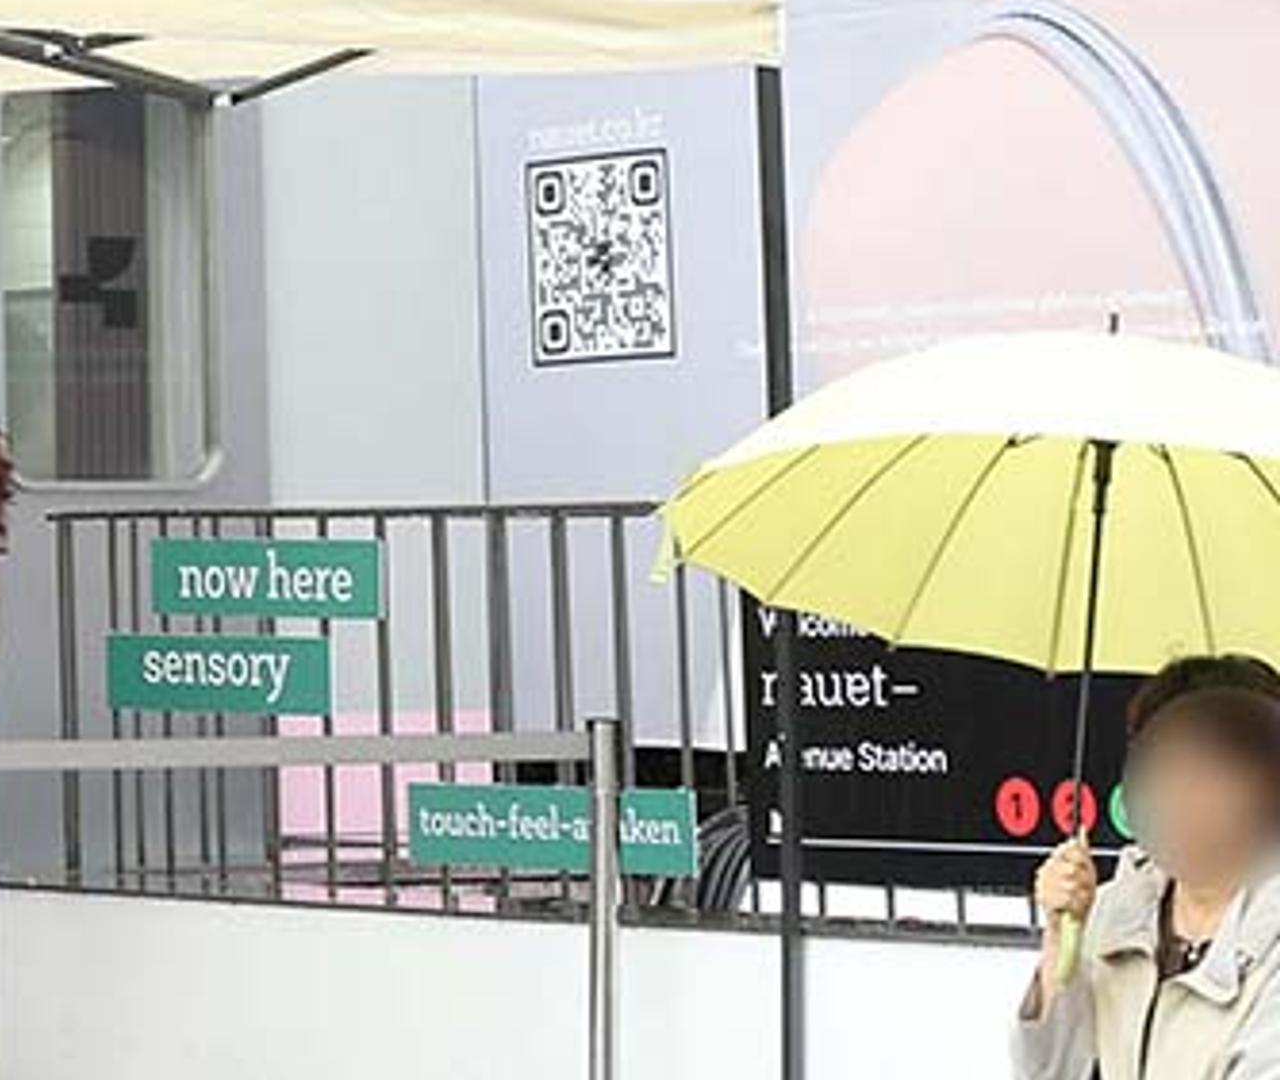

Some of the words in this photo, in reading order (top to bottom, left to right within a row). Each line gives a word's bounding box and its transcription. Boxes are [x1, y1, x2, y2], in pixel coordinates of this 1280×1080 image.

[179, 563, 257, 599] now
[267, 550, 352, 602] here
[142, 647, 290, 703] sensory
[857, 741, 947, 774] Station
